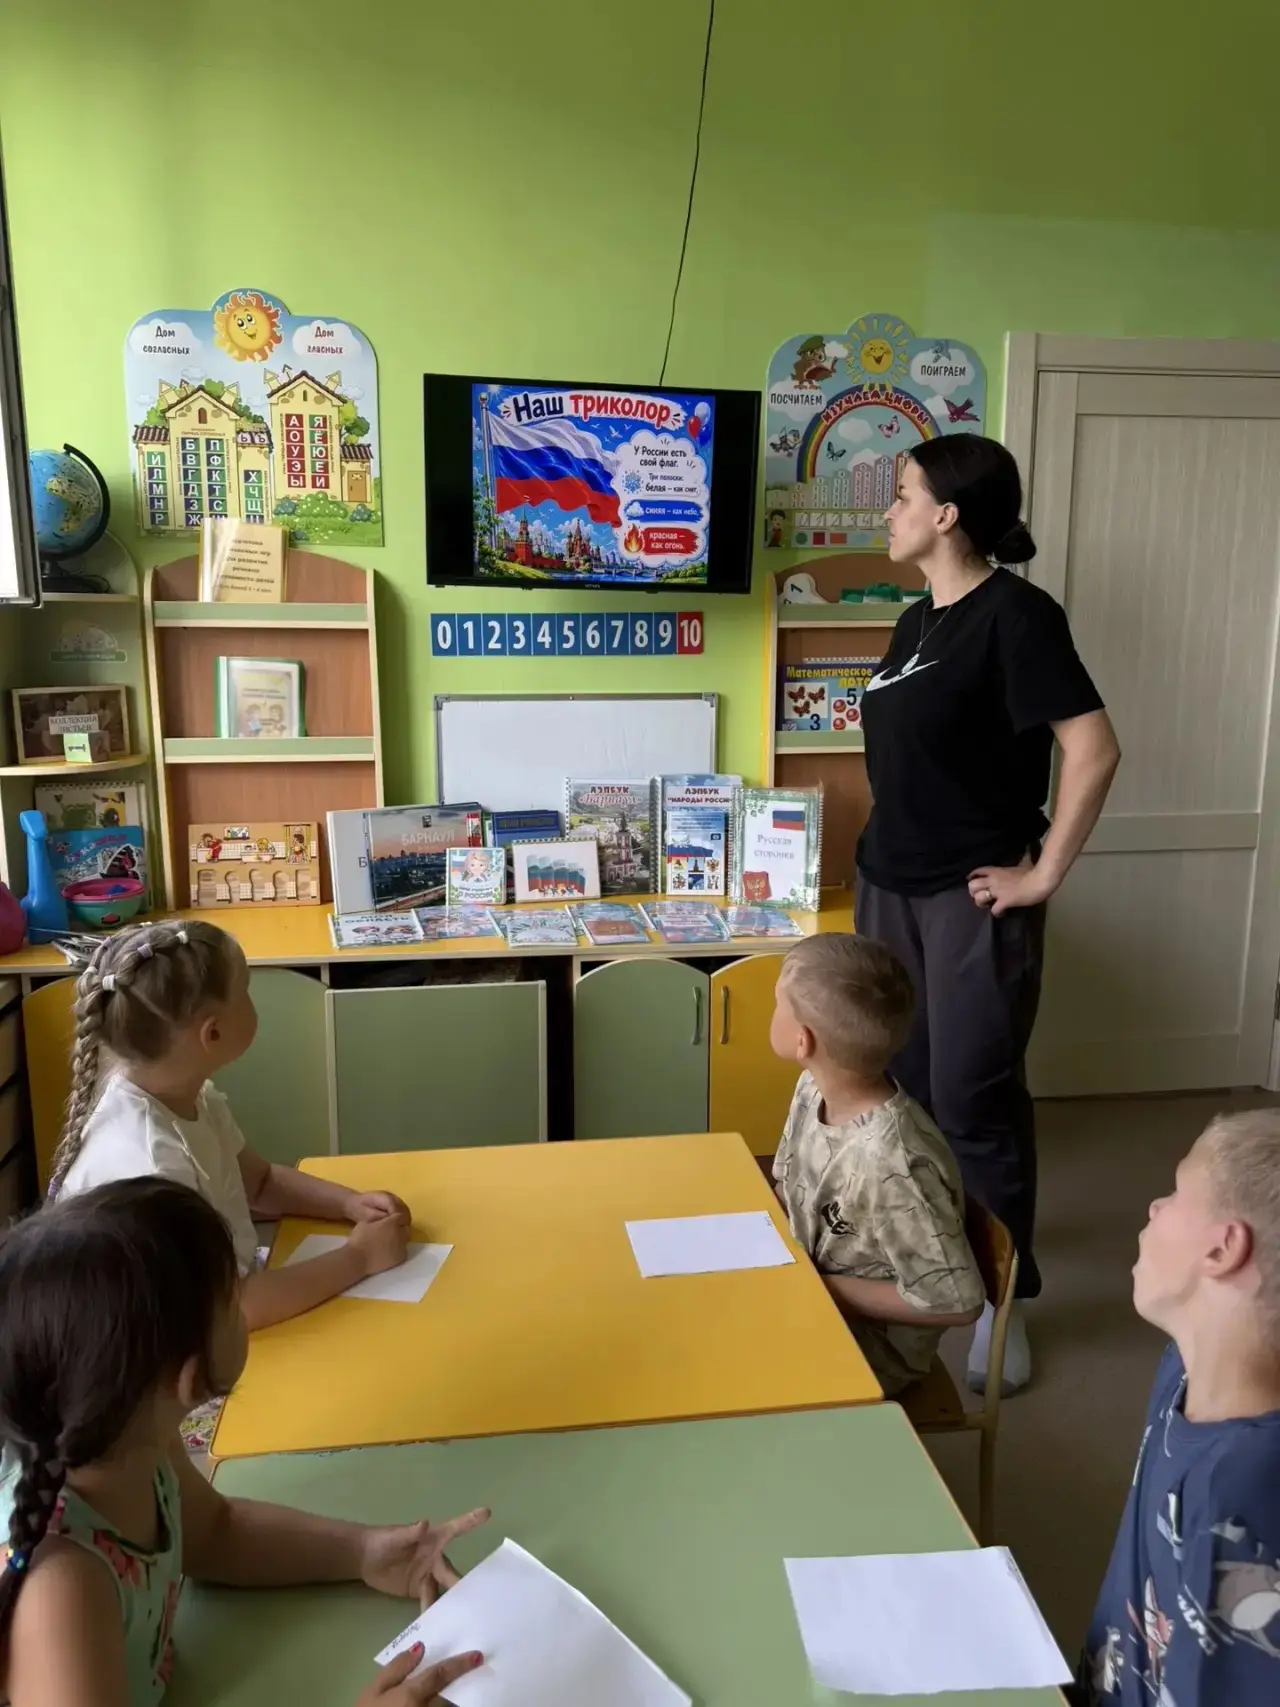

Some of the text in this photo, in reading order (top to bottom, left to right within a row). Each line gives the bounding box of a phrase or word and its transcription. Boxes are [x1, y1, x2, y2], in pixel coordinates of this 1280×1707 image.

[155, 326, 176, 338] Дом
[314, 326, 334, 338] Дом
[143, 345, 190, 355] согласных
[307, 345, 344, 354] гласных
[920, 365, 966, 377] ПОИГРАЕМ
[770, 393, 823, 406] ПОСЧИТАЕМ
[513, 393, 671, 429] Наш триколор
[821, 389, 930, 426] ИЗУЧАЕМ ЦИФРЫ
[289, 415, 323, 428] А Я
[289, 430, 300, 442] О
[186, 439, 219, 451] Б П
[290, 446, 326, 458] У Ю
[634, 445, 687, 458] У России есть
[151, 451, 161, 466] Й
[186, 455, 221, 466] В Ф
[639, 458, 679, 470] свой флаг.
[291, 460, 325, 473] Э Е
[152, 468, 163, 480] Л
[187, 469, 221, 481] Г К
[248, 471, 258, 483] Х
[648, 473, 659, 482] Три
[290, 475, 325, 488] Ы И
[645, 482, 666, 493] белая
[152, 484, 164, 495] М
[188, 484, 222, 496] Д Т
[248, 486, 258, 498] Ч
[154, 498, 164, 509] Н
[189, 500, 223, 511] З С
[247, 500, 261, 513] Щ
[645, 507, 666, 515] синяя
[155, 513, 164, 525] Р
[188, 513, 201, 525] Ж
[649, 532, 678, 540] красная
[437, 619, 701, 649] 0 1 2 3 4 5 6 7 8 9 10
[786, 666, 873, 678] Математическое
[846, 688, 857, 706] 5
[810, 713, 820, 731] 3
[590, 786, 630, 794] ЛЭПБУК
[685, 787, 720, 795] ЛЭПБУК
[401, 829, 455, 845] БАРНАУЛ
[756, 834, 792, 846] Русская
[754, 850, 795, 861] сторонка
